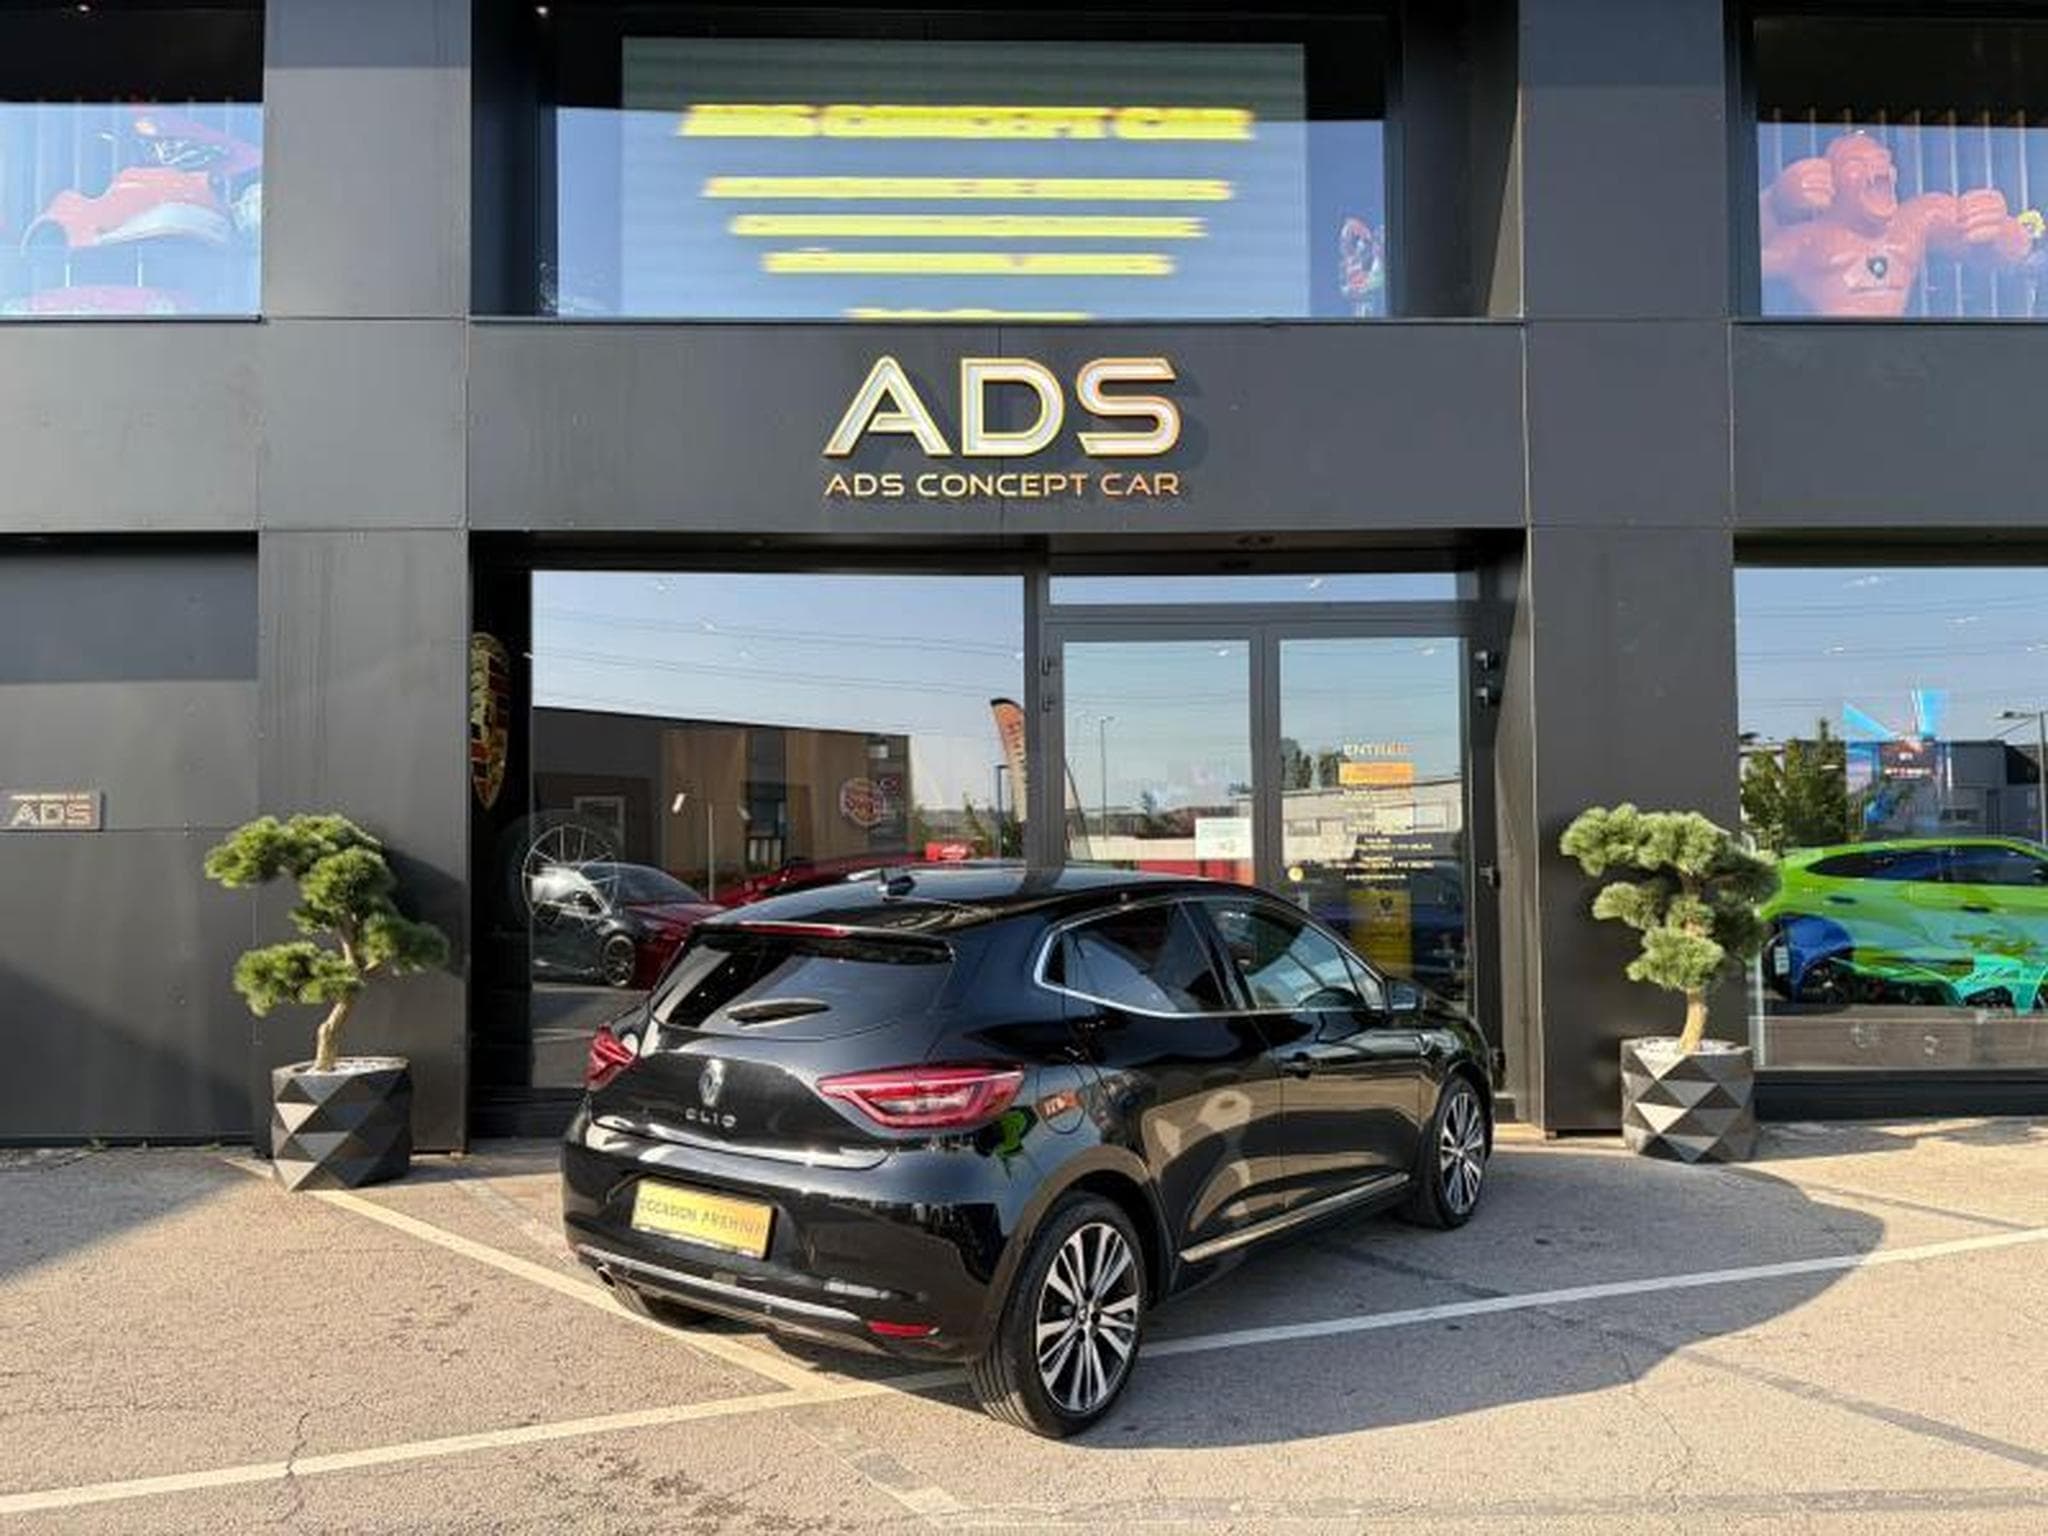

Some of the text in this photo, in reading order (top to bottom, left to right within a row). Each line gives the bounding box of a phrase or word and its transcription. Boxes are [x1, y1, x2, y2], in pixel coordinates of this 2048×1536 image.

[823, 355, 1182, 456] ADS
[824, 473, 1180, 497] ADS CONCEPT CAR
[10, 801, 91, 826] ADS
[685, 1107, 737, 1128] CLIO
